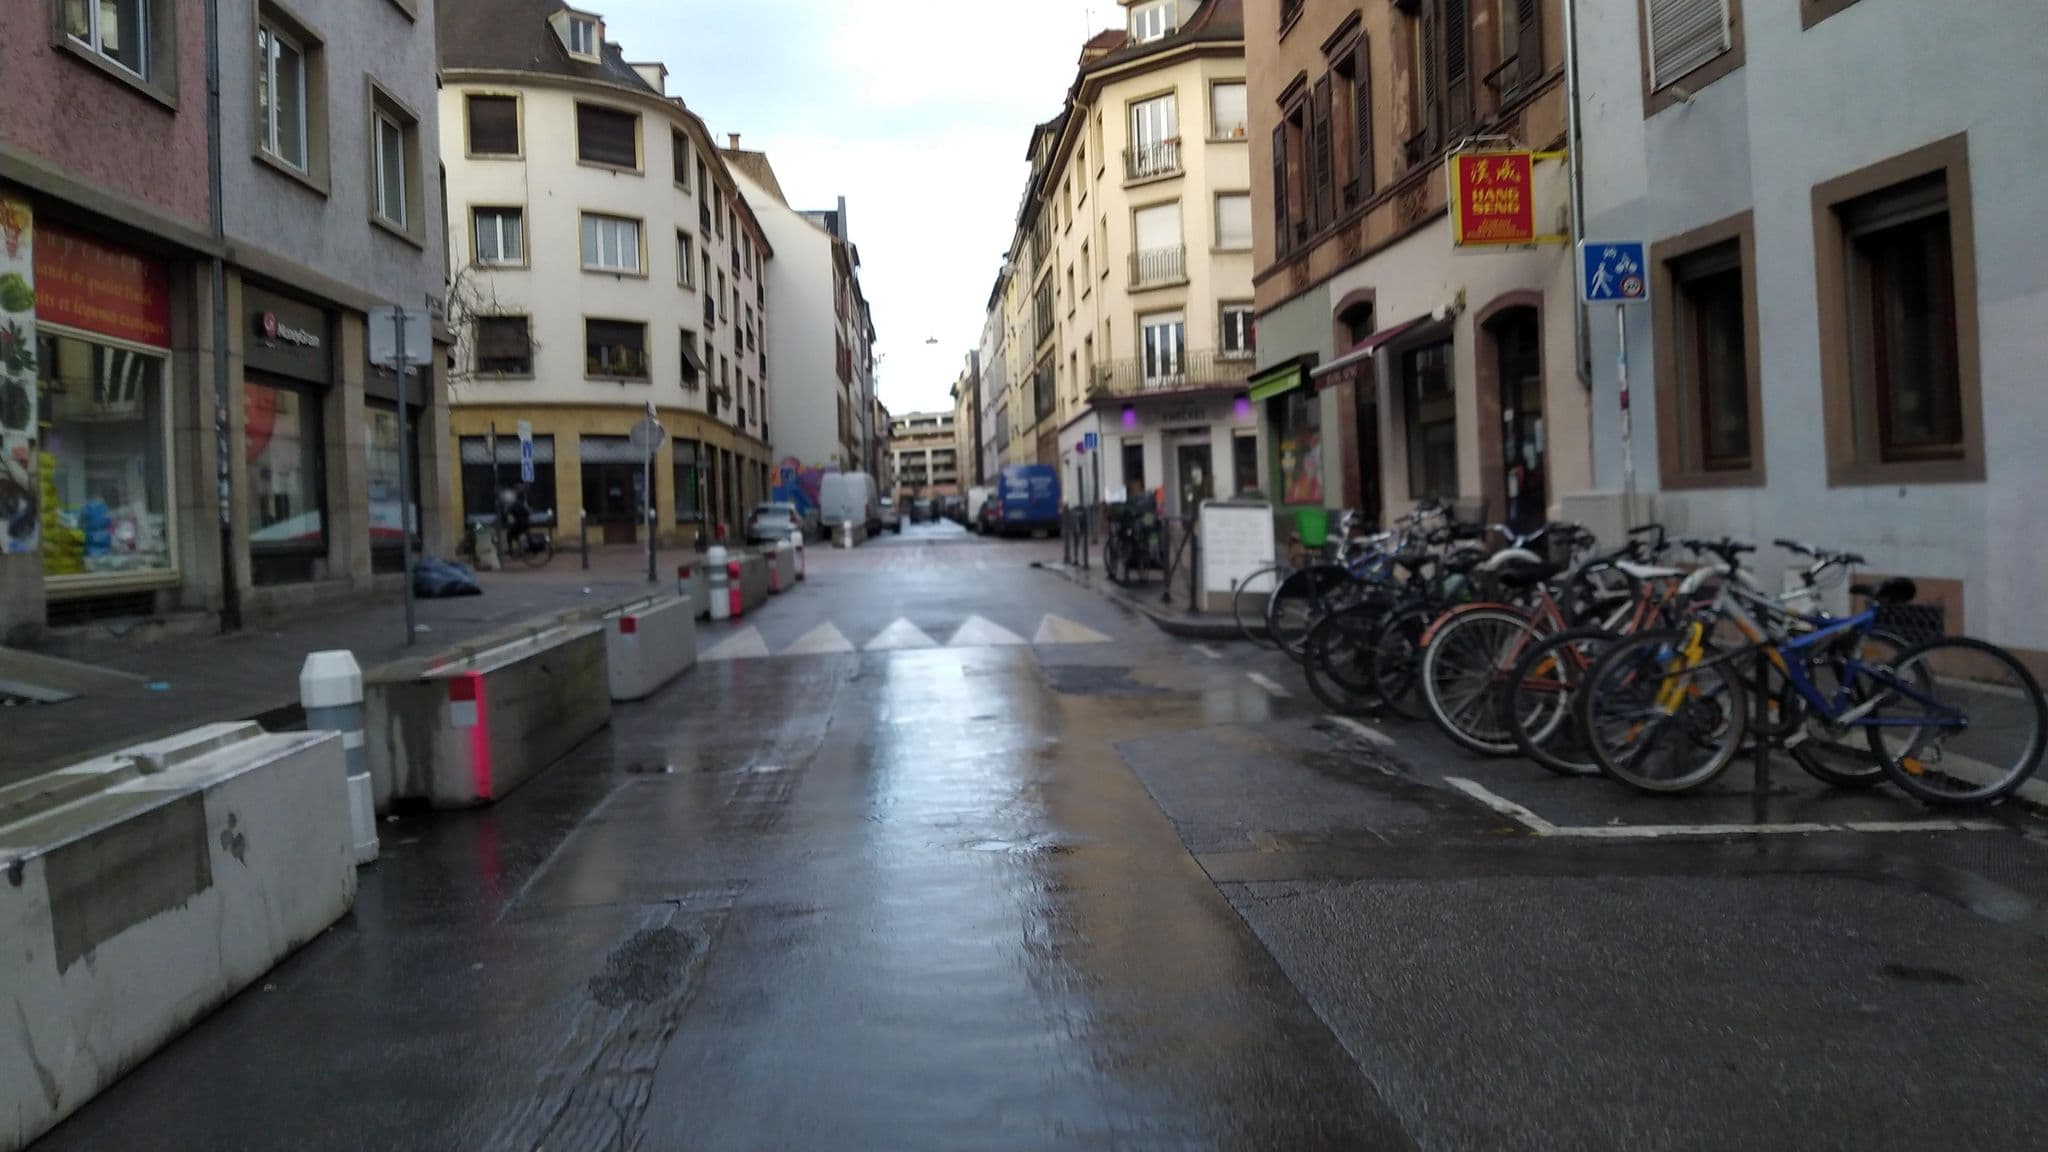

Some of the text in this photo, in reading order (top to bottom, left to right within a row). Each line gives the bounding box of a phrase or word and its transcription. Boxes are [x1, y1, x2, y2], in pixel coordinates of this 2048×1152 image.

[1472, 187, 1520, 202] HANG
[1472, 201, 1521, 216] SENG
[277, 322, 321, 348] MoneyGram
